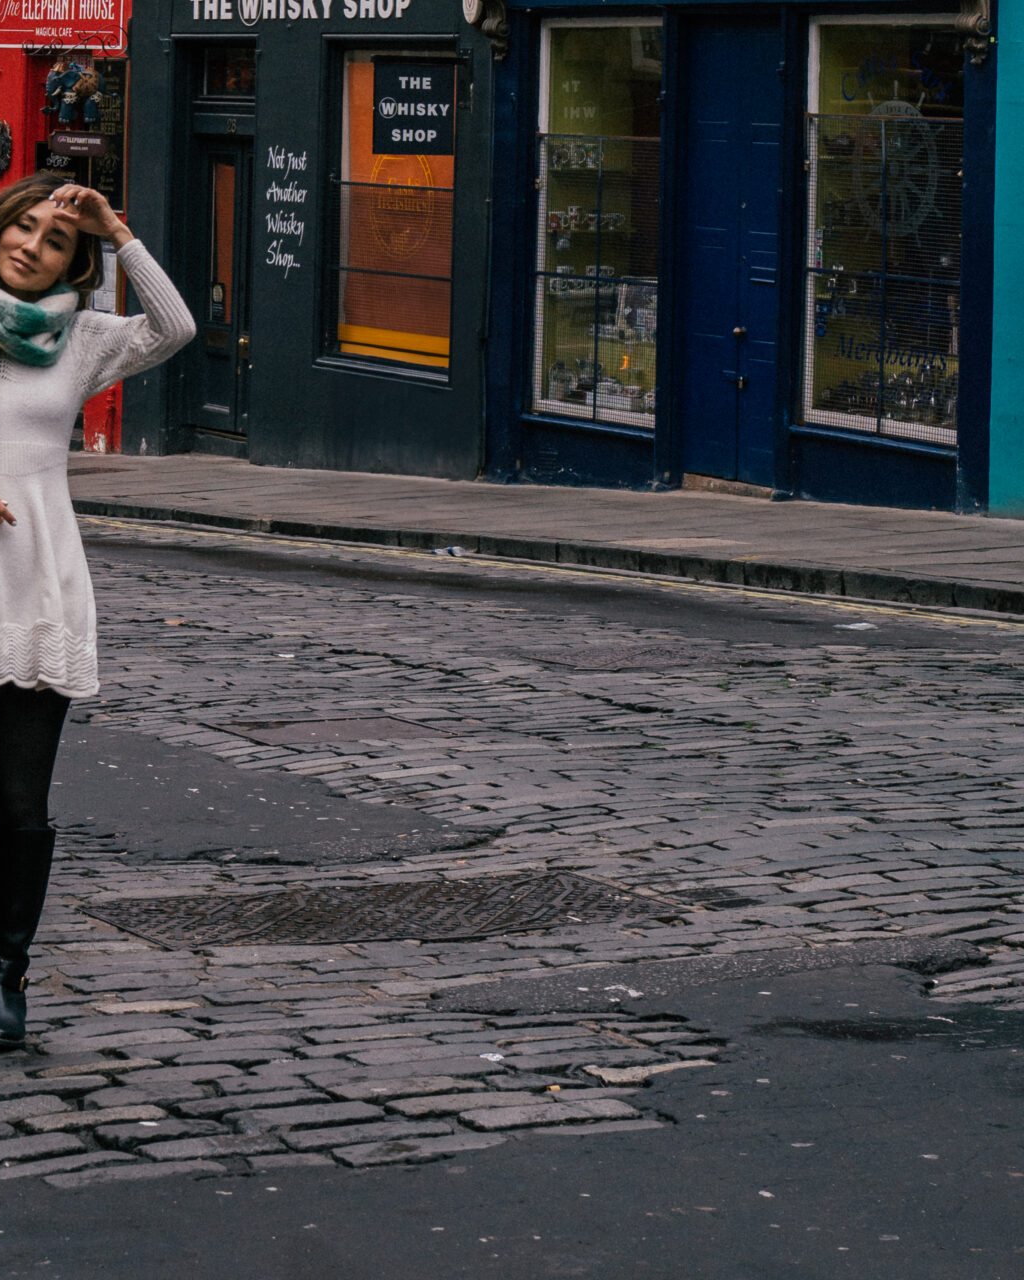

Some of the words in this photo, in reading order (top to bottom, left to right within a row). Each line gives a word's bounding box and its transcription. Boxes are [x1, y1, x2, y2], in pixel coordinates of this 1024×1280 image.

[35, 27, 58, 37] MAGICAL
[398, 76, 432, 90] THE
[381, 102, 450, 117] WHISKY
[391, 128, 437, 142] SHOP
[267, 145, 285, 169] Not
[284, 151, 307, 180] Just
[266, 181, 308, 203] Another
[265, 210, 304, 247] Whisky
[266, 239, 301, 279] Shop...
